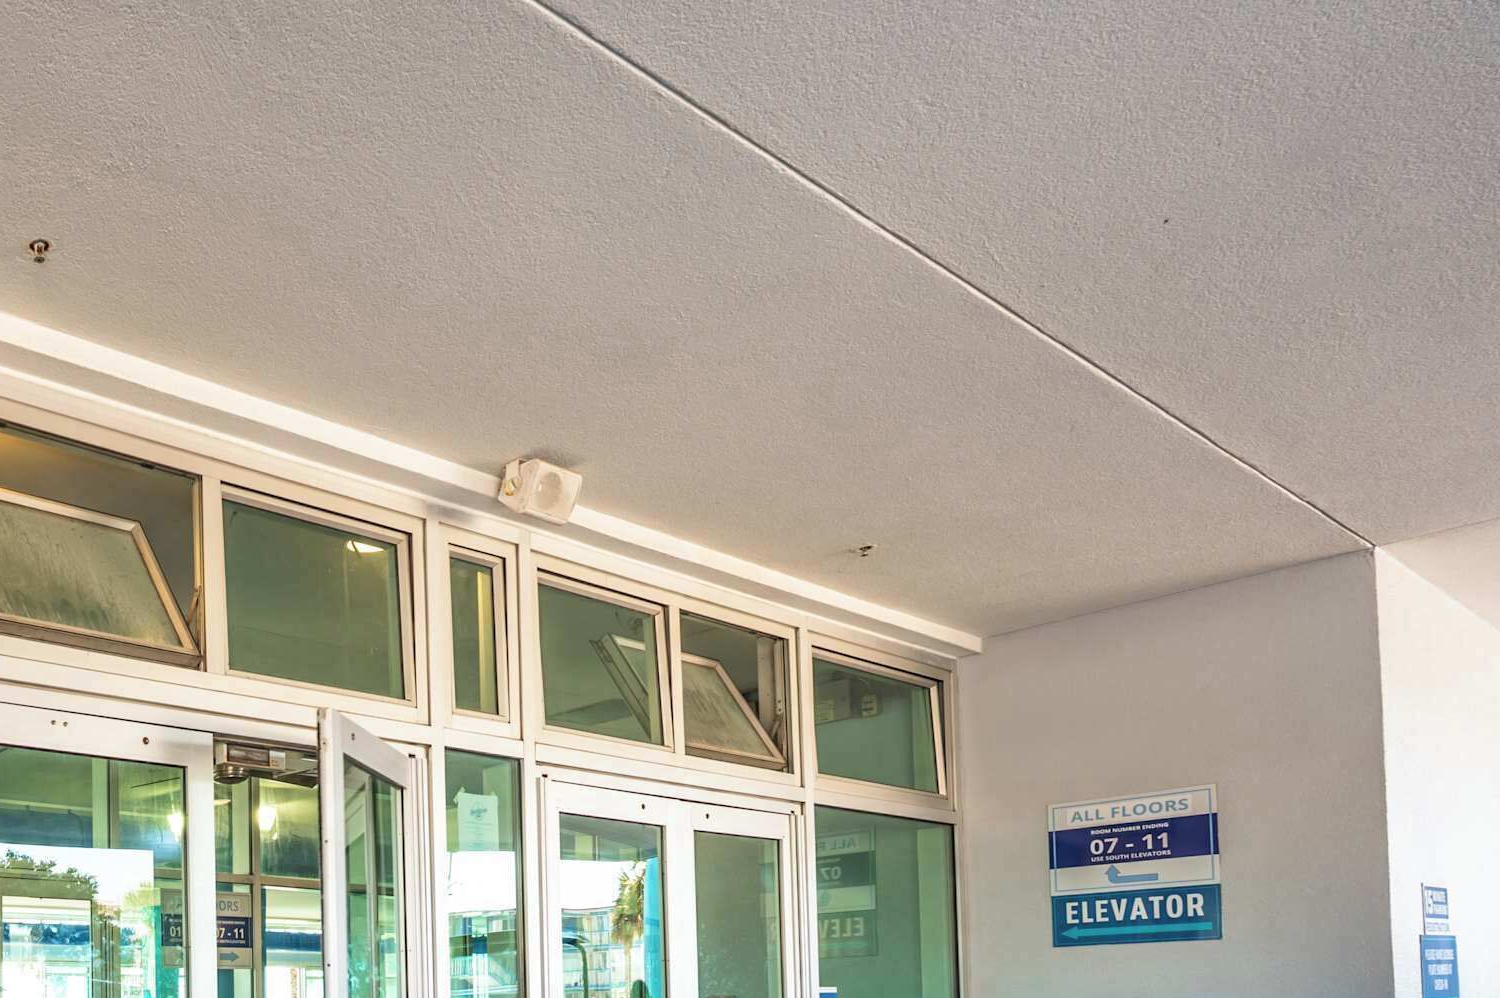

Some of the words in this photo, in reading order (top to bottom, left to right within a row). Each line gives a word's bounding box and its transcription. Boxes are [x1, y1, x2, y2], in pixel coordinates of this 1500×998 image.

[1070, 809, 1104, 823] ALL
[1111, 798, 1189, 818] FLOORS
[1112, 825, 1141, 833] NUMBER
[1142, 822, 1169, 830] ENDING
[1090, 837, 1119, 855] 07
[1142, 832, 1169, 850] 11
[1131, 849, 1172, 858] ELEVATORS
[216, 900, 239, 912] ORS
[1065, 893, 1205, 924] ELEVATOR
[233, 928, 245, 939] 11
